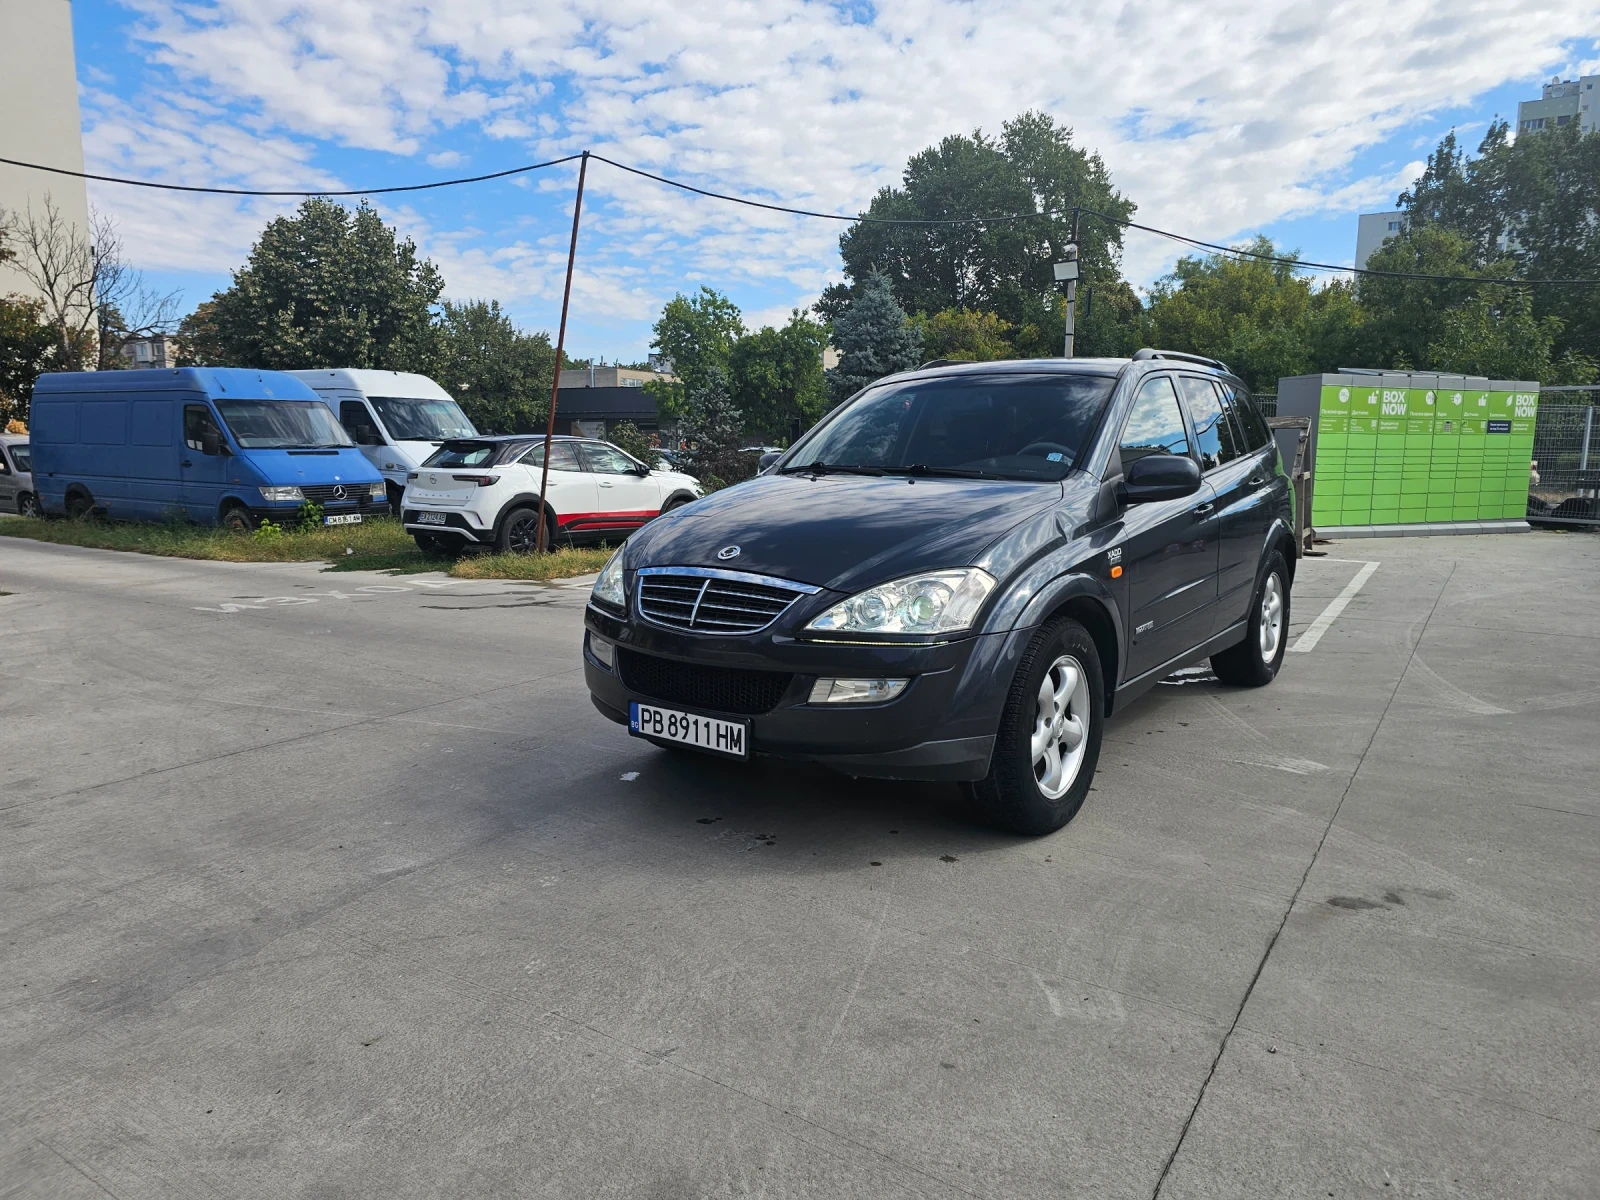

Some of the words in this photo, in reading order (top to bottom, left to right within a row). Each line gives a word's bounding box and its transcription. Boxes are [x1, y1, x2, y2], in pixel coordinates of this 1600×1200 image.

[1383, 391, 1405, 403] BOX
[1516, 395, 1535, 406] BOX
[1382, 403, 1407, 415] NOW
[1515, 407, 1536, 417] NOW
[631, 720, 639, 729] BG
[641, 707, 664, 735] PB
[668, 713, 710, 745] 8911
[716, 723, 742, 753] HM
